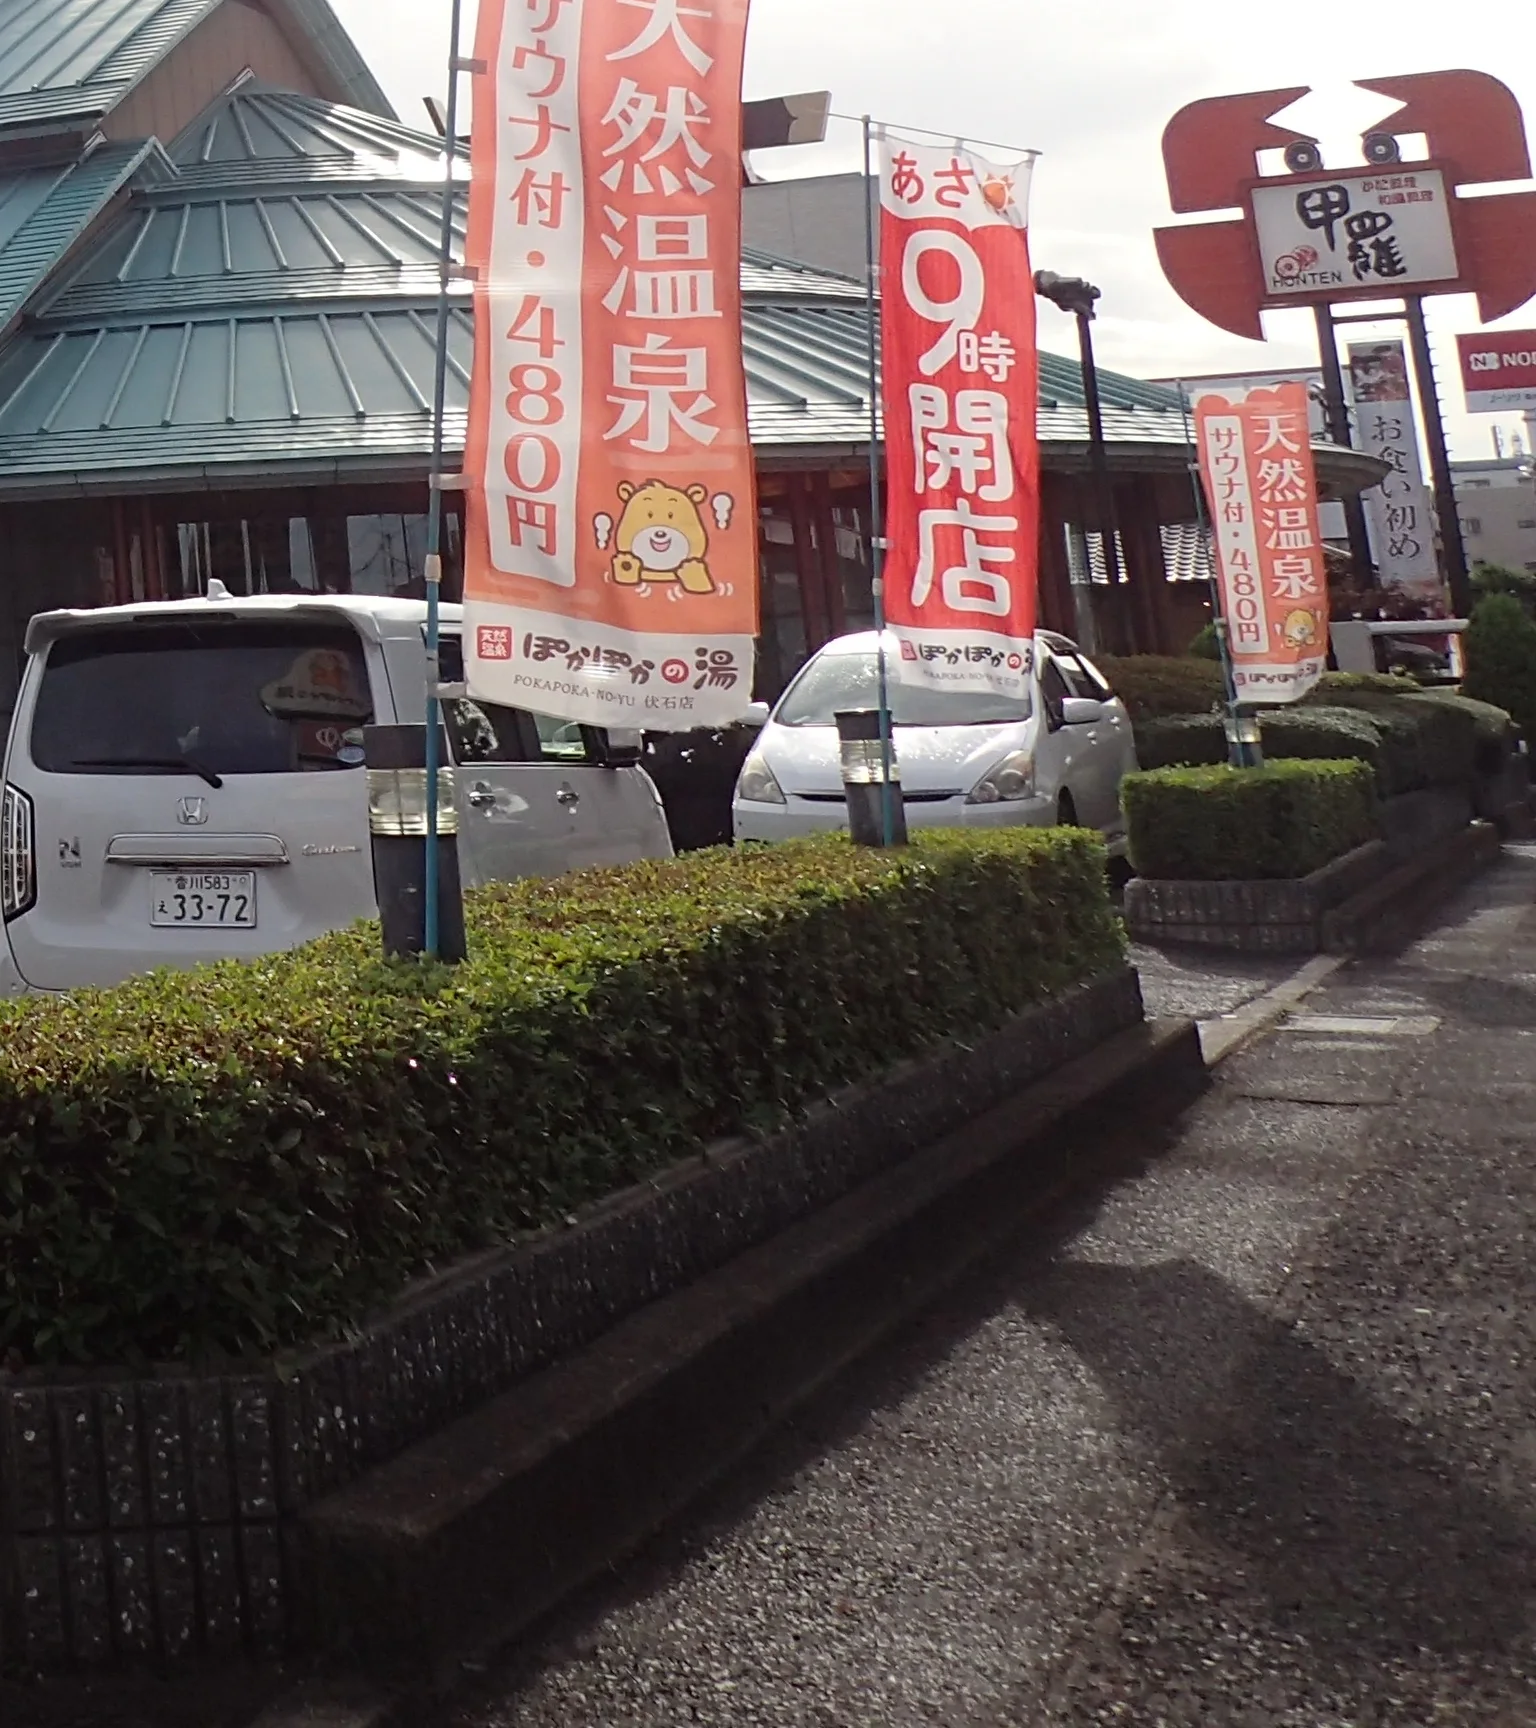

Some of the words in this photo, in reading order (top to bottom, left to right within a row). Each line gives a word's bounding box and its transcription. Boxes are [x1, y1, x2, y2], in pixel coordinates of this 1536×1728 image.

[890, 149, 971, 210] あさ
[1272, 272, 1343, 288] HONTEN
[1250, 413, 1318, 599] 天然温泉
[175, 875, 230, 890] 香川583
[173, 894, 249, 922] 33-72
